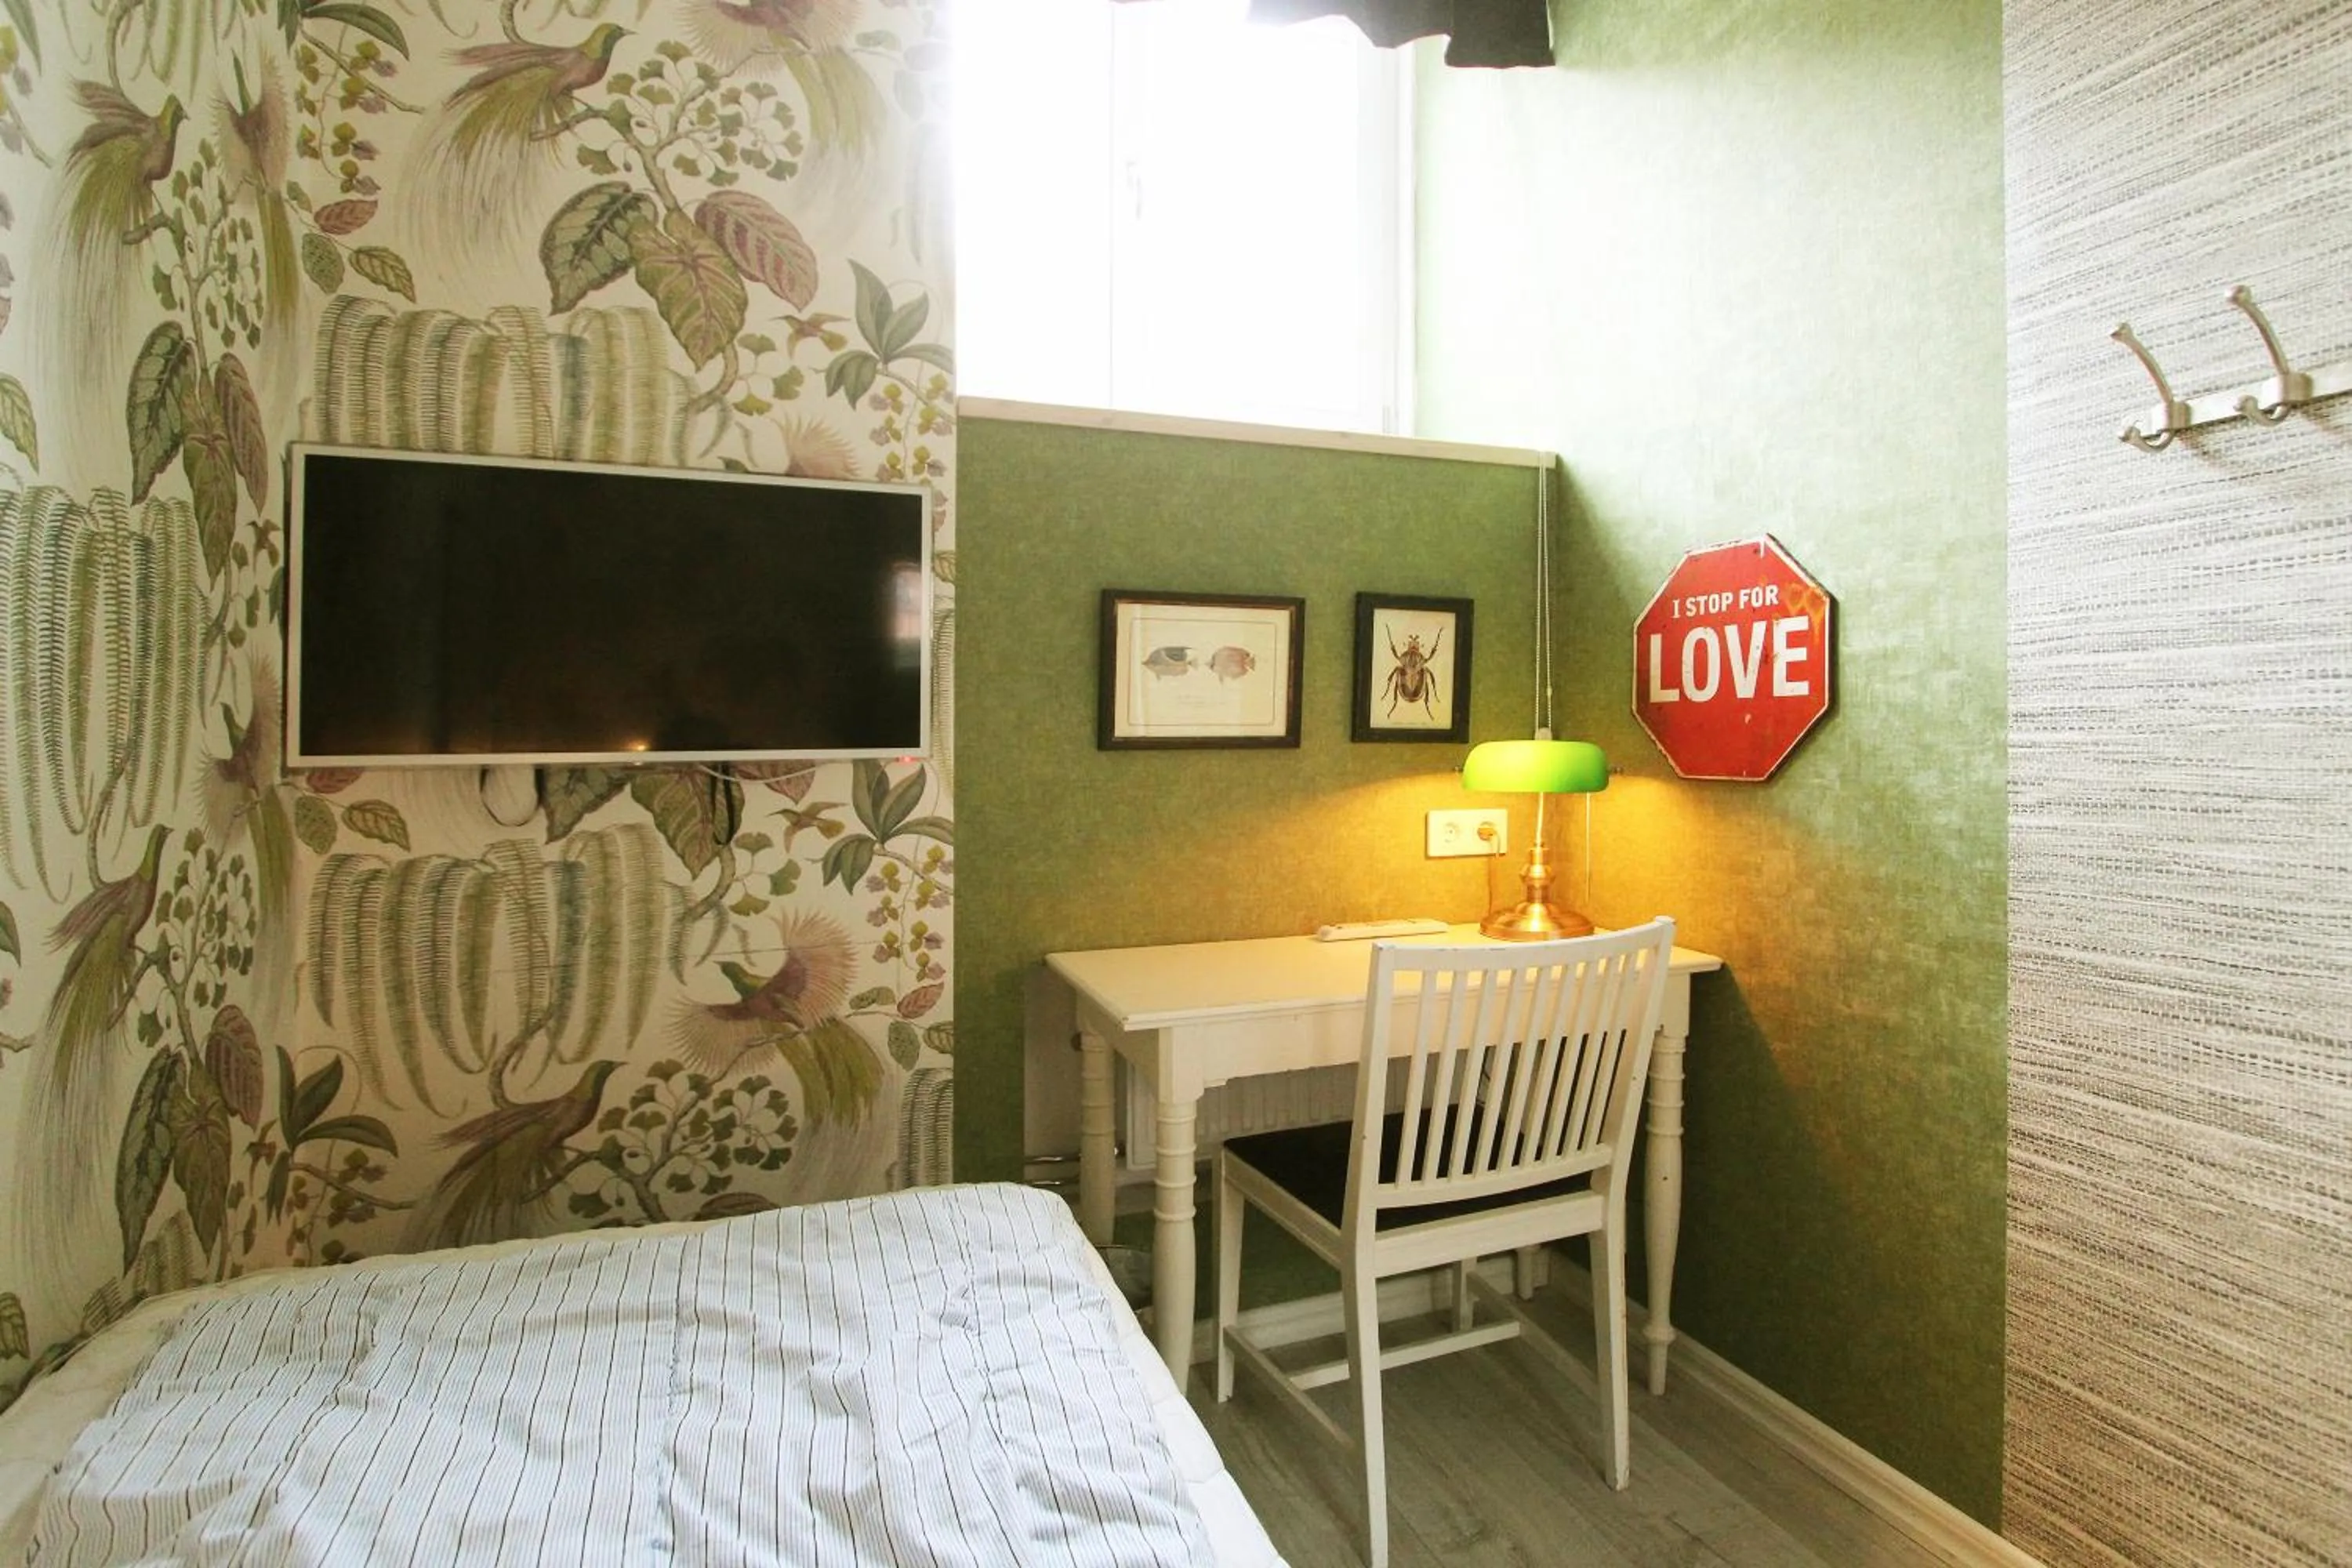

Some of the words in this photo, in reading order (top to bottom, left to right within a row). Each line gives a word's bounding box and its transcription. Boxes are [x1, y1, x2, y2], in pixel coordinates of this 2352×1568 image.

[1672, 599, 1680, 618] I
[1686, 592, 1733, 617] STOP
[1740, 585, 1779, 609] FOR
[1650, 615, 1809, 702] LOVE
